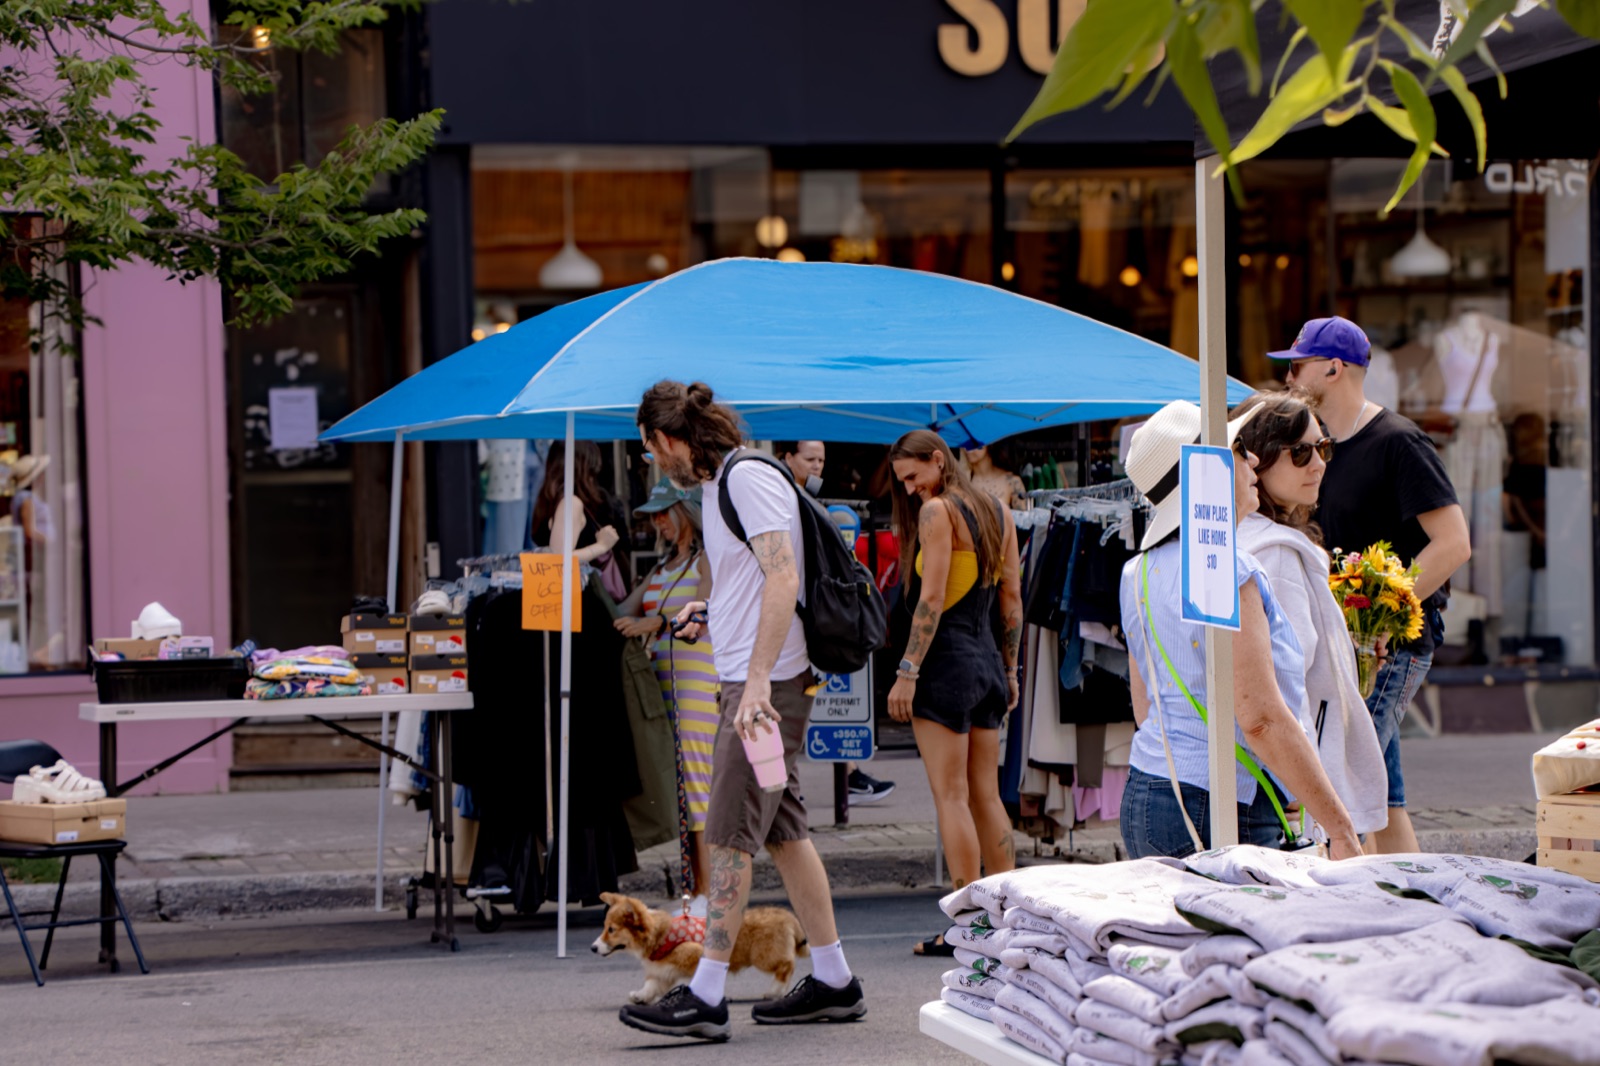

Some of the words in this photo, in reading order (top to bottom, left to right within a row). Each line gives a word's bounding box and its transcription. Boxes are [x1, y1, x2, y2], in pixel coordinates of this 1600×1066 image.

[1194, 503, 1211, 521] SNOW
[1212, 504, 1228, 523] PLACE
[1198, 528, 1210, 545] LIKE
[1211, 529, 1227, 547] HOME
[1207, 553, 1217, 570] $10
[528, 562, 551, 576] UP
[815, 697, 827, 706] BY
[829, 697, 861, 706] PERMIT
[827, 707, 850, 716] ONLY
[842, 739, 861, 748] SET
[840, 748, 863, 757] FINE
